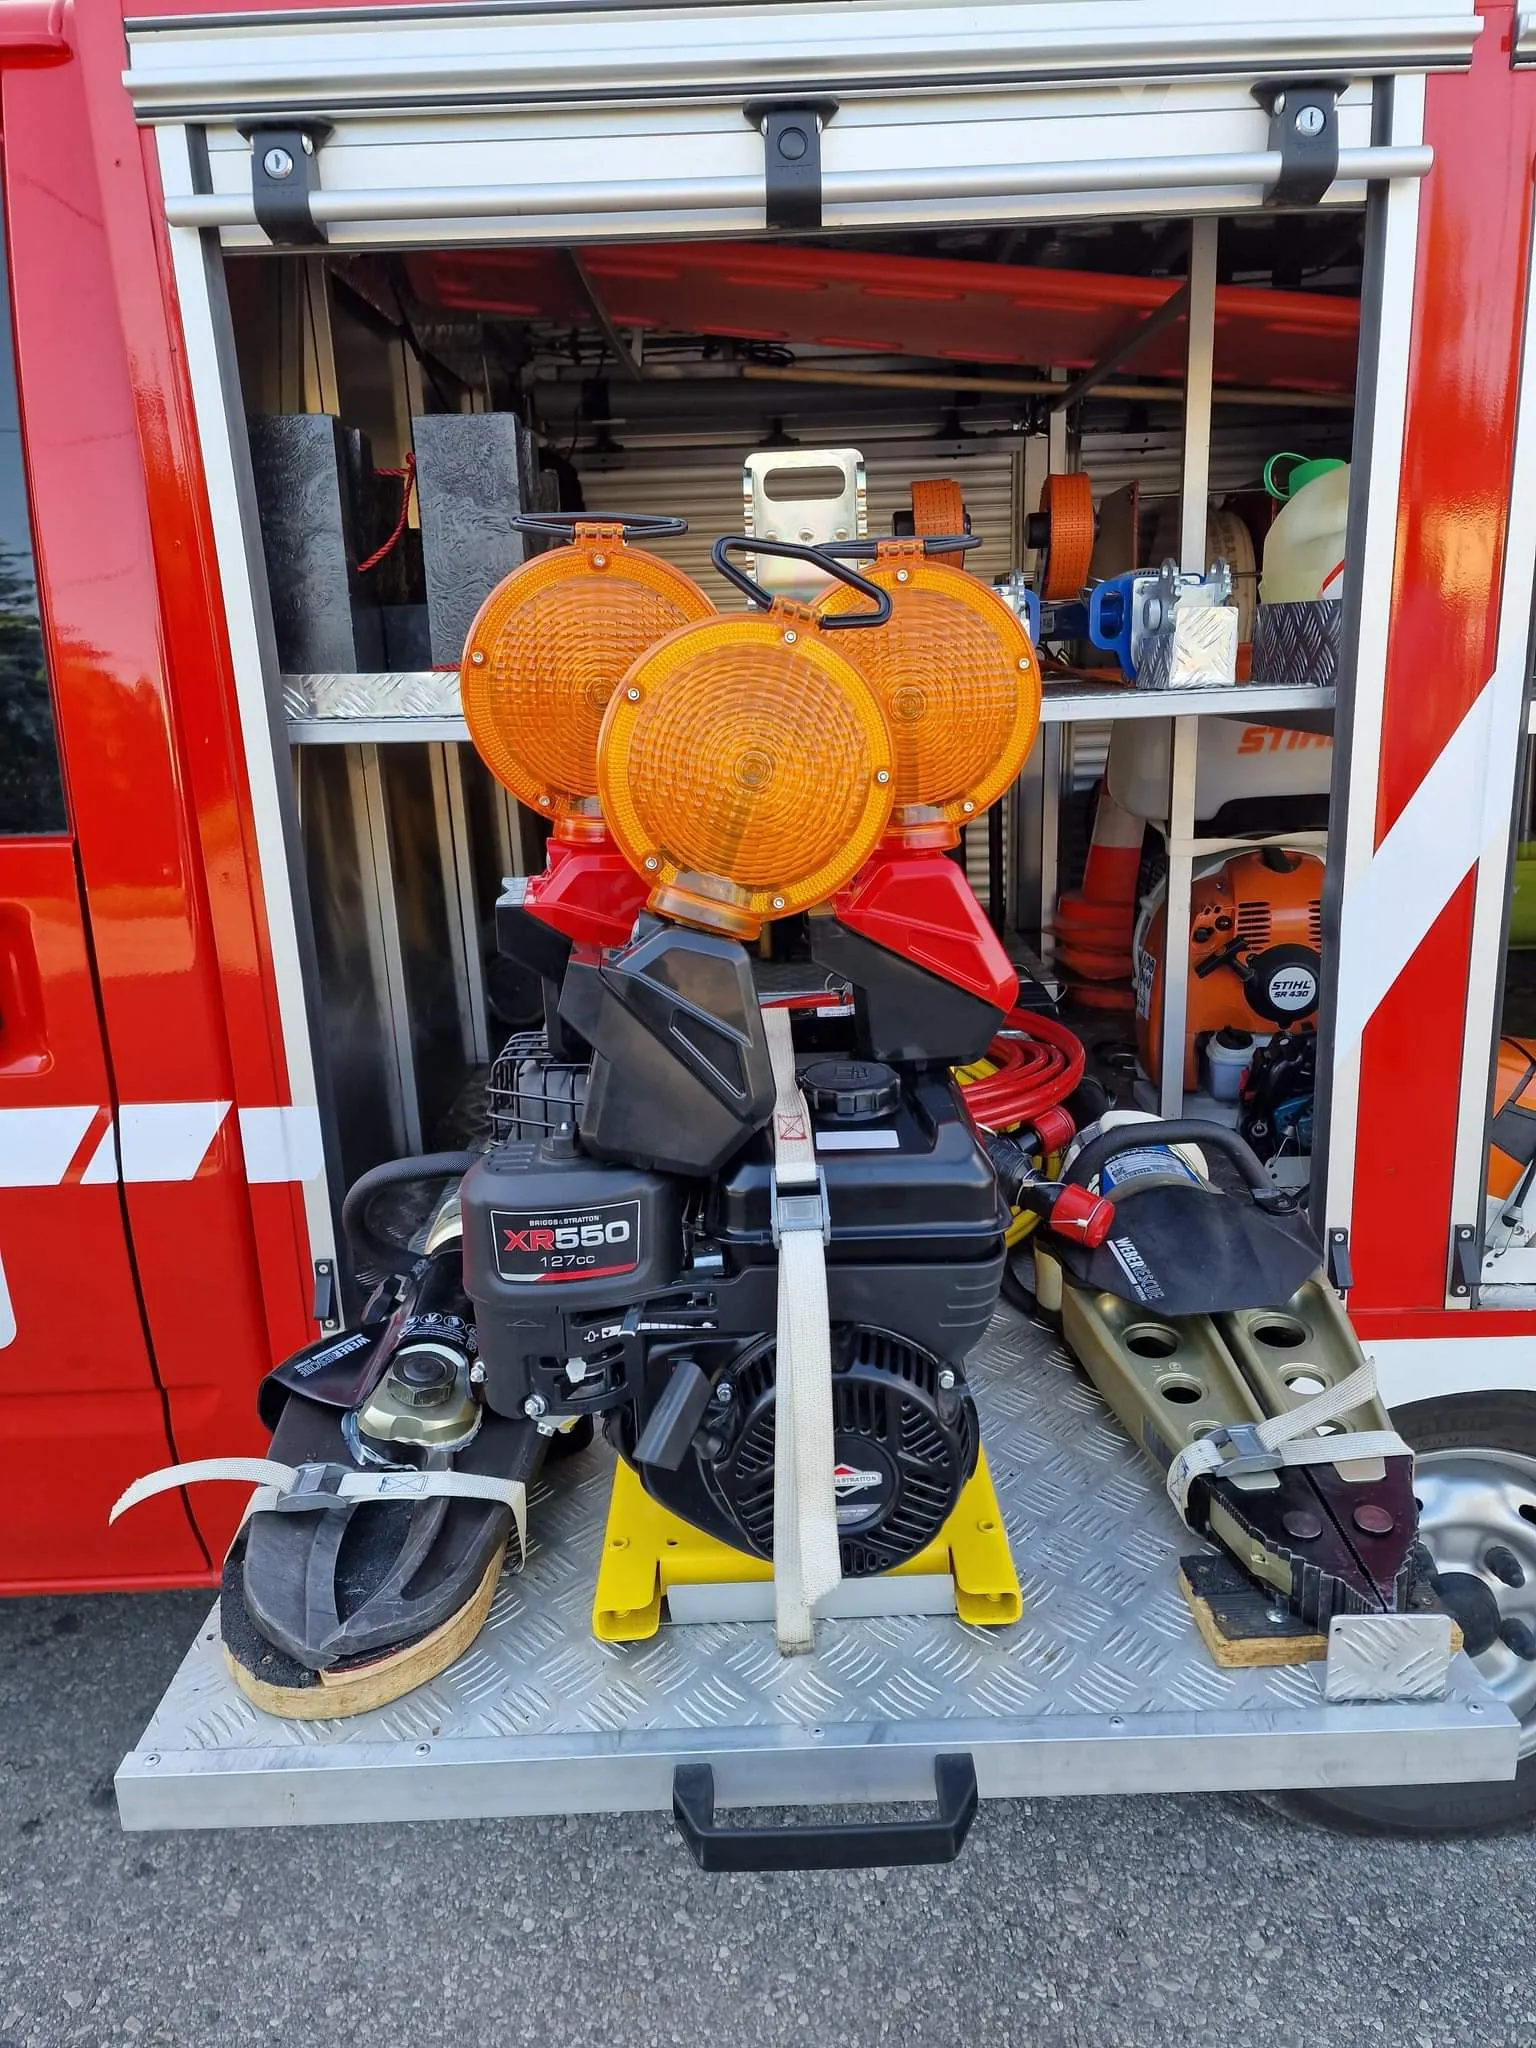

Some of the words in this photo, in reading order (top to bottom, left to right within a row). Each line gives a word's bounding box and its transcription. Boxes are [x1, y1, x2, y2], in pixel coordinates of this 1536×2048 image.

[1271, 980, 1311, 990] STIHL
[504, 1220, 629, 1251] XR550
[540, 1254, 595, 1268] 127cc
